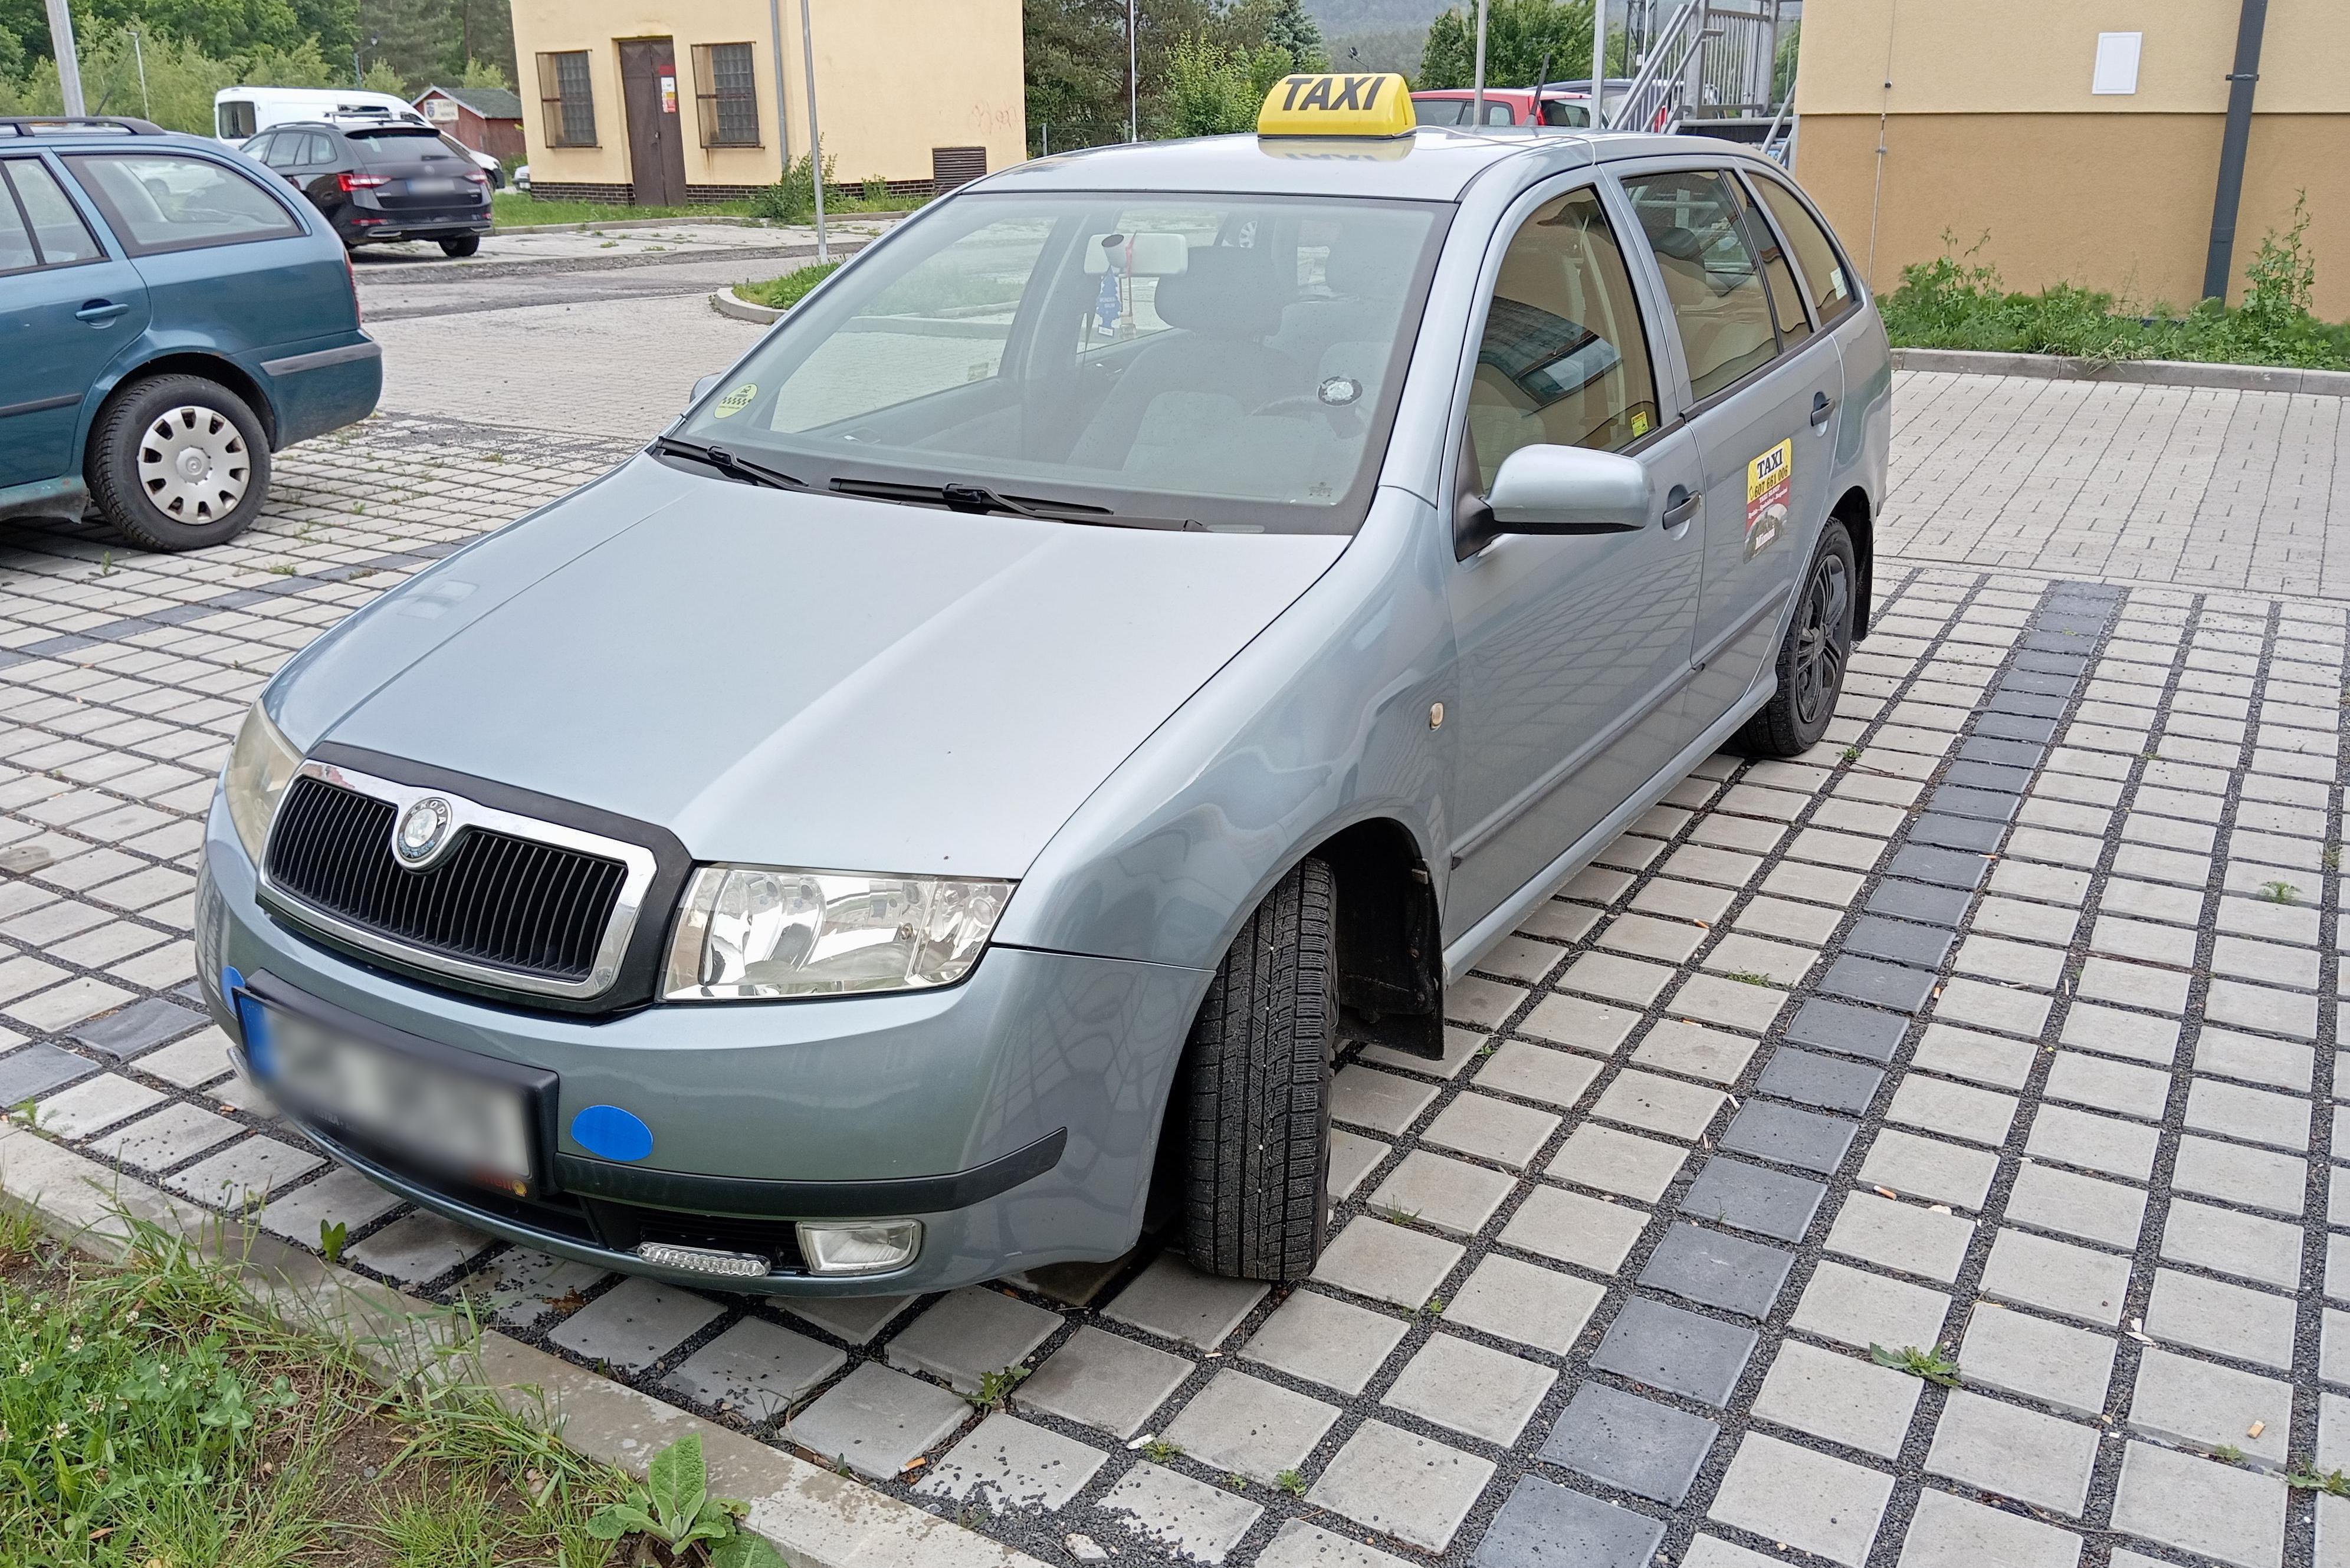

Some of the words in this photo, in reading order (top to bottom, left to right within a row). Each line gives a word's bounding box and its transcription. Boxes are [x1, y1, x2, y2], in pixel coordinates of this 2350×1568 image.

[1282, 77, 1386, 110] TAXI
[1757, 448, 1783, 479] TAXI
[1754, 481, 1765, 497] 607
[1767, 474, 1776, 489] 661
